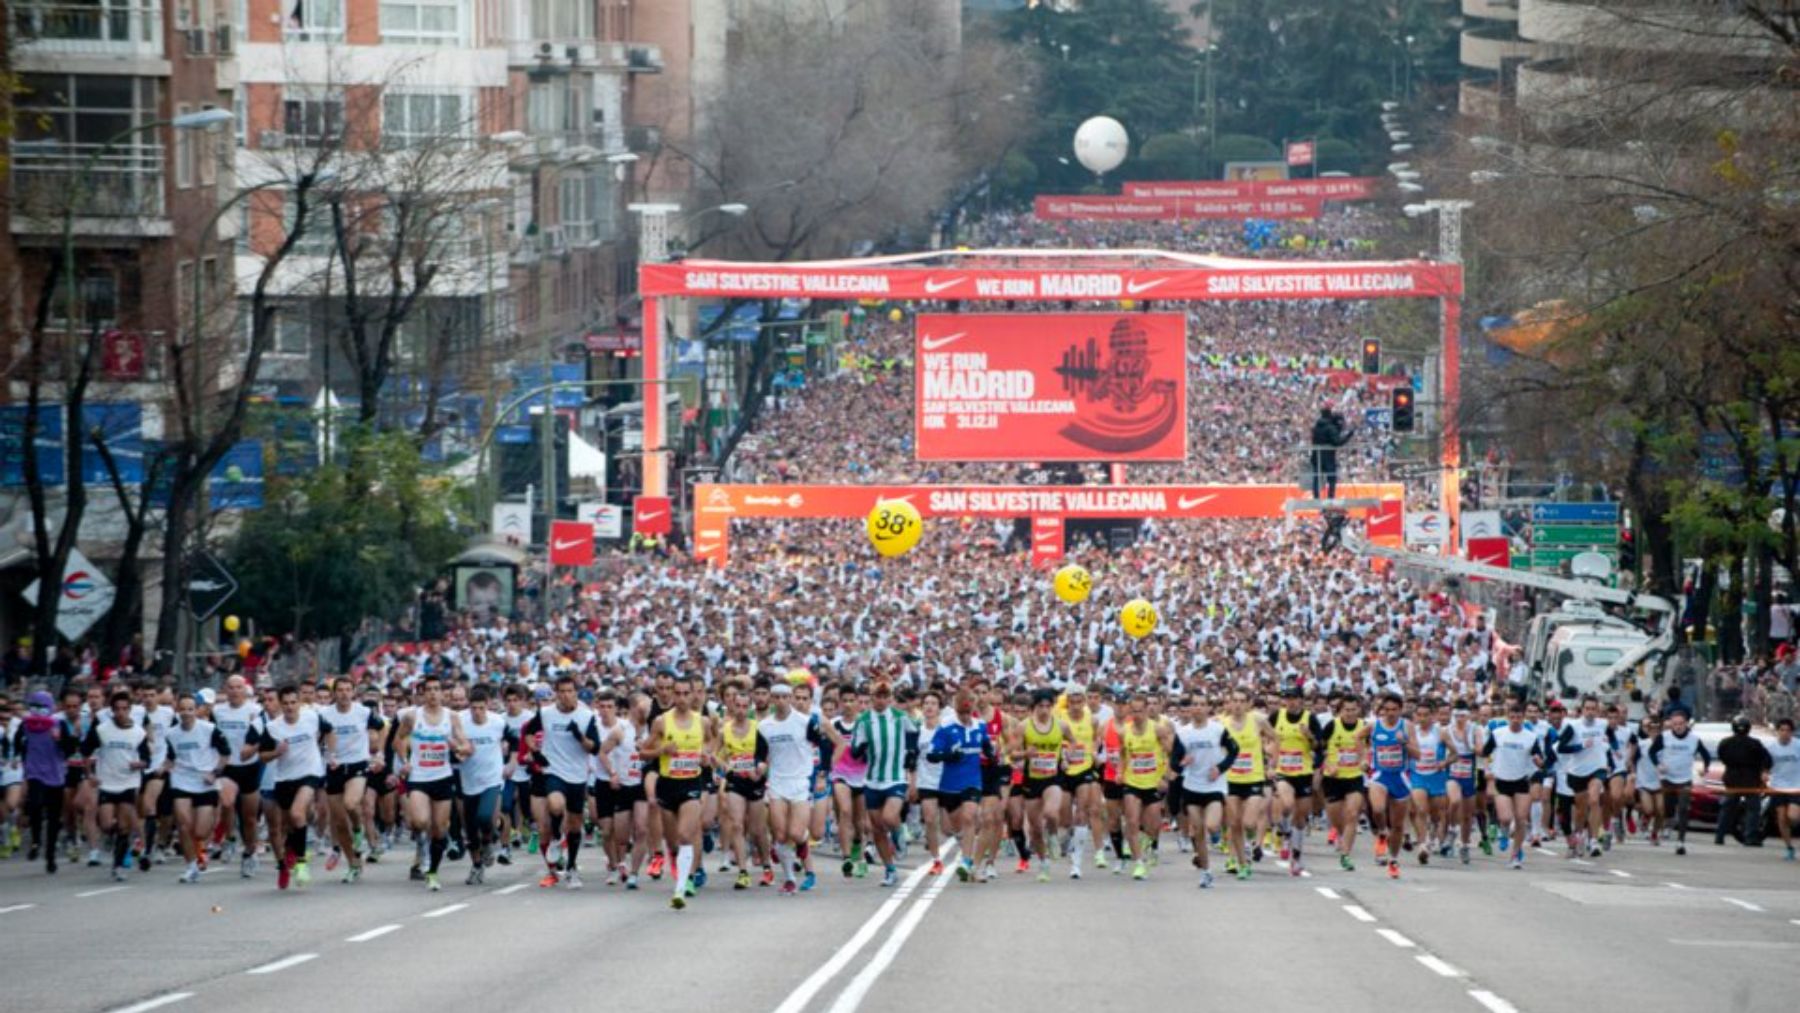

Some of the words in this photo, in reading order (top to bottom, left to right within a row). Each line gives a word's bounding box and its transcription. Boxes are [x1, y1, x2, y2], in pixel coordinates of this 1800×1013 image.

[686, 273, 717, 289] SAN
[719, 273, 800, 291] SILVESTRE
[801, 275, 890, 292] VALLECANA
[977, 278, 1001, 295] WE
[1003, 279, 1035, 296] RUN
[1041, 274, 1123, 296] MADRID
[1207, 276, 1239, 293] SAN
[1241, 275, 1324, 292] SILVESTRE
[1325, 273, 1414, 291] VALLECANA
[923, 353, 950, 369] WE
[952, 353, 987, 369] RUN
[923, 370, 1035, 399] MADRID
[923, 401, 946, 413] SAN
[947, 401, 1009, 413] SILVESTRE
[1009, 401, 1076, 413] VALLECANA
[929, 492, 968, 511] SAN
[969, 492, 1063, 511] SILVESTRE
[1065, 491, 1167, 511] VALLECANA
